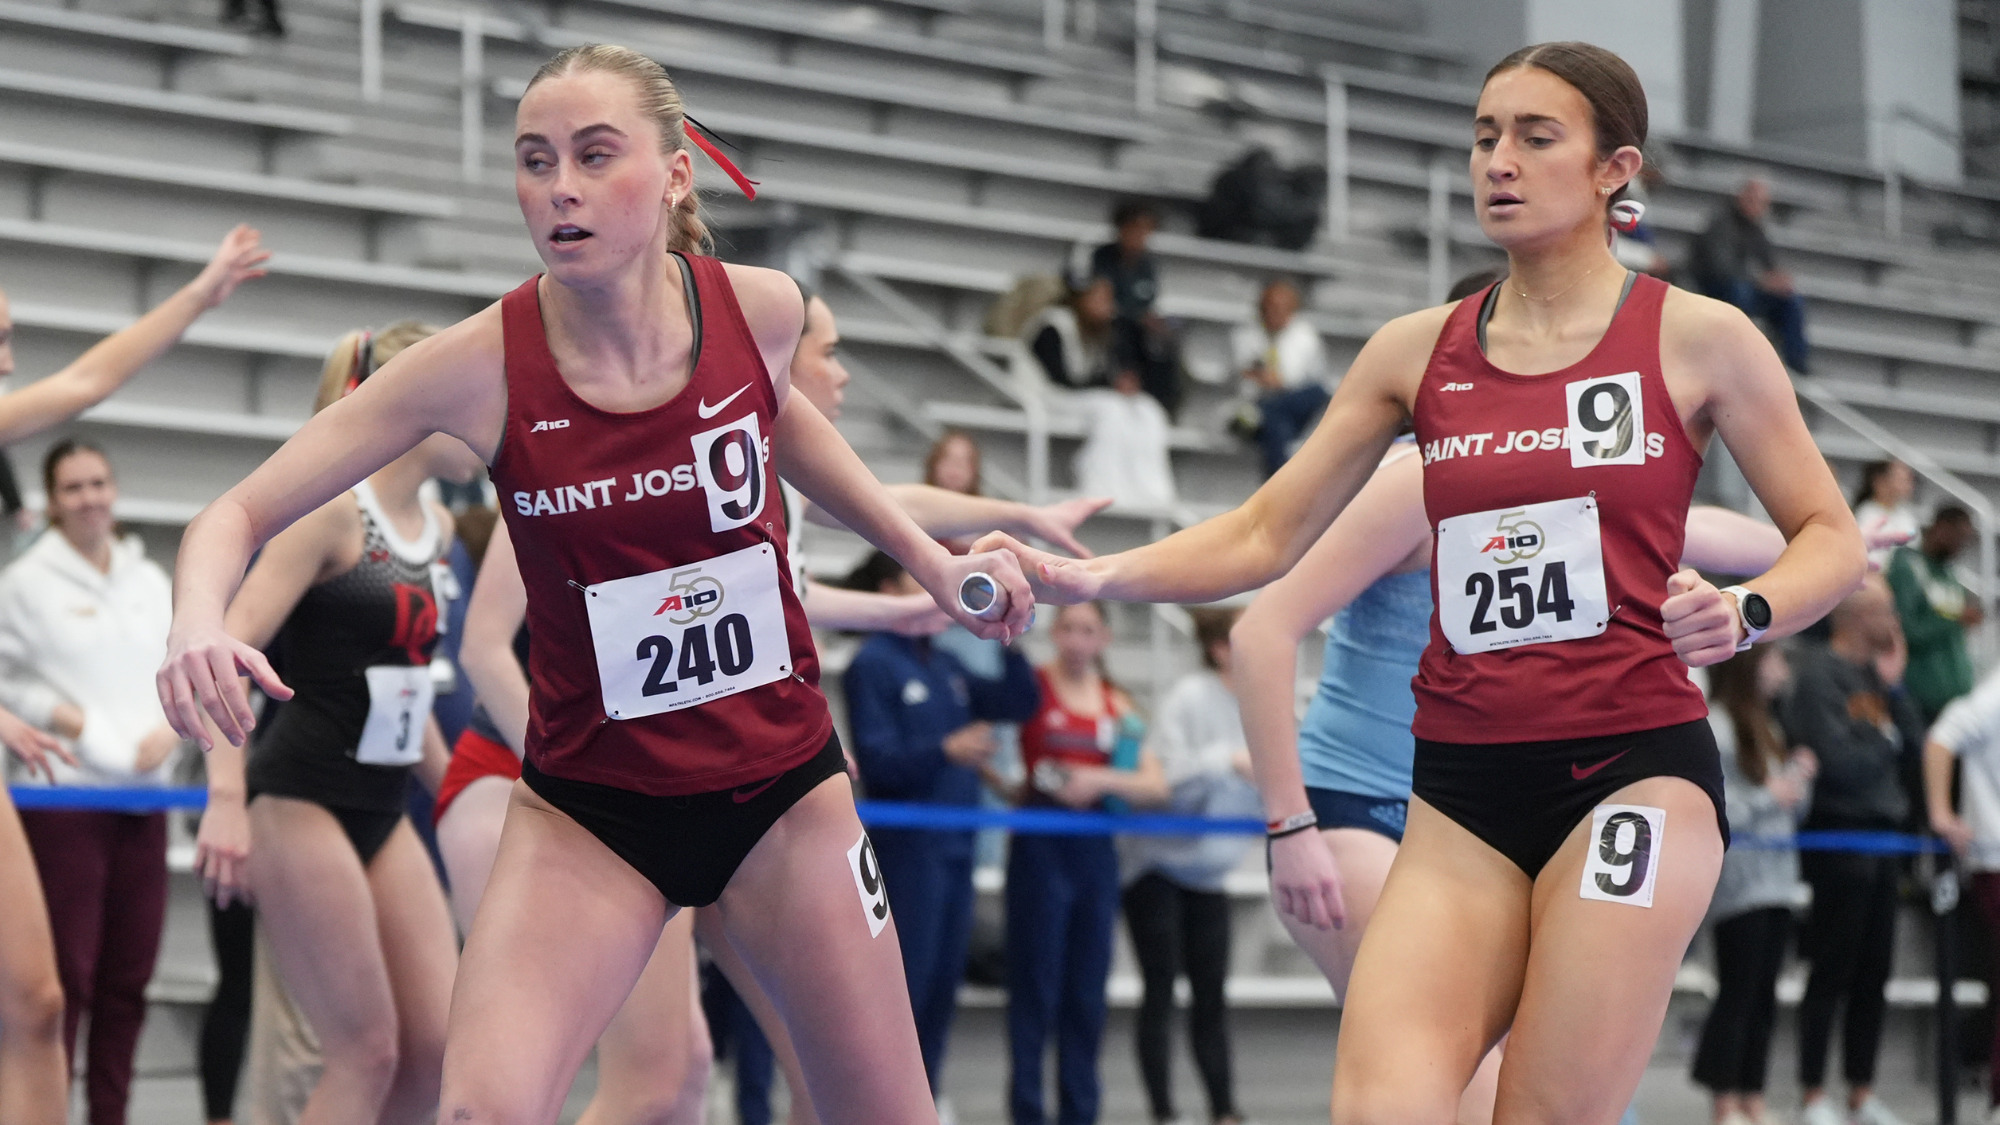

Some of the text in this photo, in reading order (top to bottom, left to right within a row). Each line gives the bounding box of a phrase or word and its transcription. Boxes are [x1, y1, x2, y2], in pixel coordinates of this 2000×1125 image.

[1440, 382, 1474, 392] A10
[530, 418, 571, 433] A10
[1423, 432, 1494, 467] SAINT
[1577, 382, 1634, 459] 9
[513, 476, 617, 517] SAINT
[708, 428, 761, 521] 9
[1480, 533, 1539, 554] A10
[652, 588, 718, 617] A10
[1465, 561, 1576, 636] 254
[635, 612, 754, 698] 240
[859, 834, 888, 921] 9
[1594, 811, 1652, 897] 9
